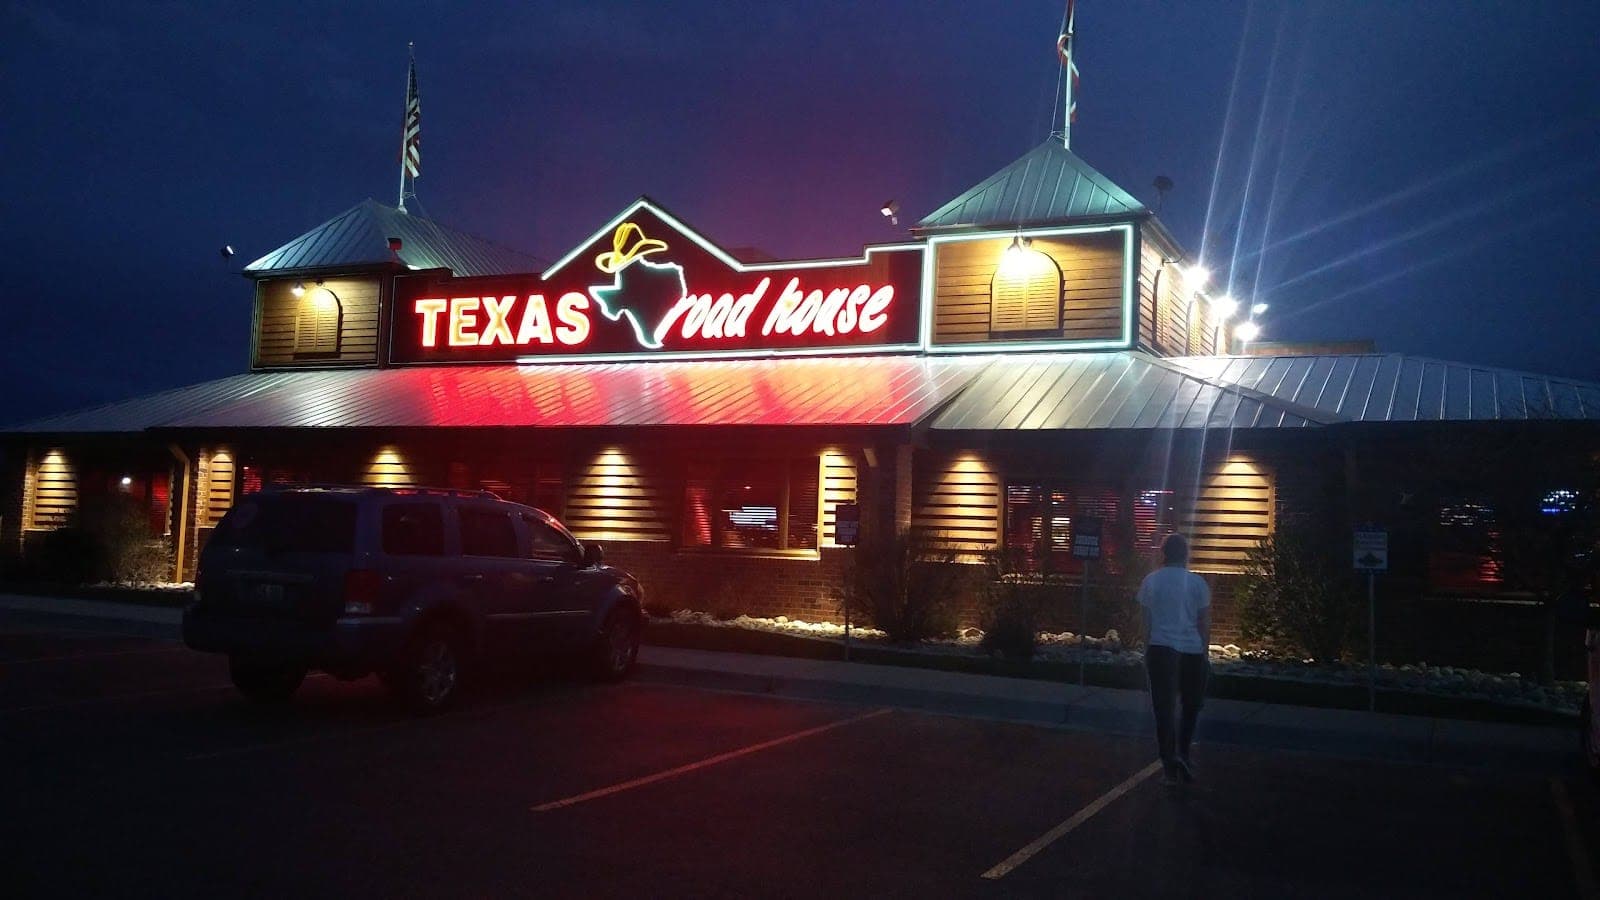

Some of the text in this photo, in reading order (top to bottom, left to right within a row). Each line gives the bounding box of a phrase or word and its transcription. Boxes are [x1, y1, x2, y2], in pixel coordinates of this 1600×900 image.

[415, 276, 895, 347] TEXAS road house
